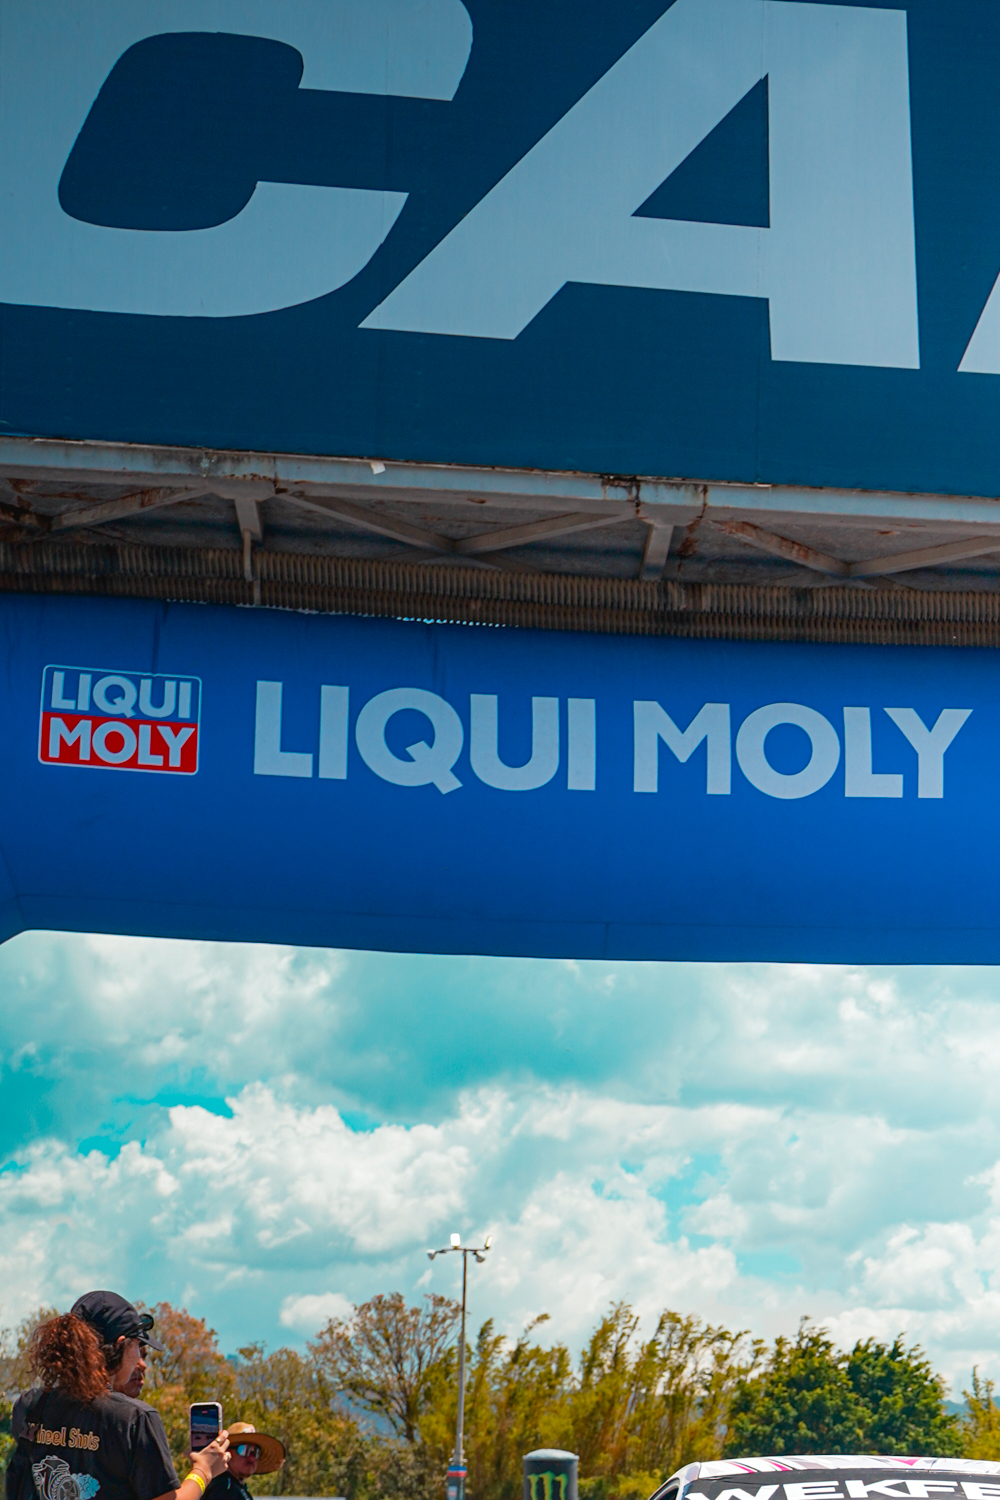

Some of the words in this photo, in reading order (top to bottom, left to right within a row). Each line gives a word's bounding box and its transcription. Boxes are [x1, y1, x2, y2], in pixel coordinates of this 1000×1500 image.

[51, 671, 192, 719] LIQUI
[49, 717, 196, 767] MOLY
[253, 680, 596, 795] LIQUI
[633, 700, 974, 799] MOLY
[28, 1422, 67, 1447] heel
[68, 1427, 100, 1451] Shots
